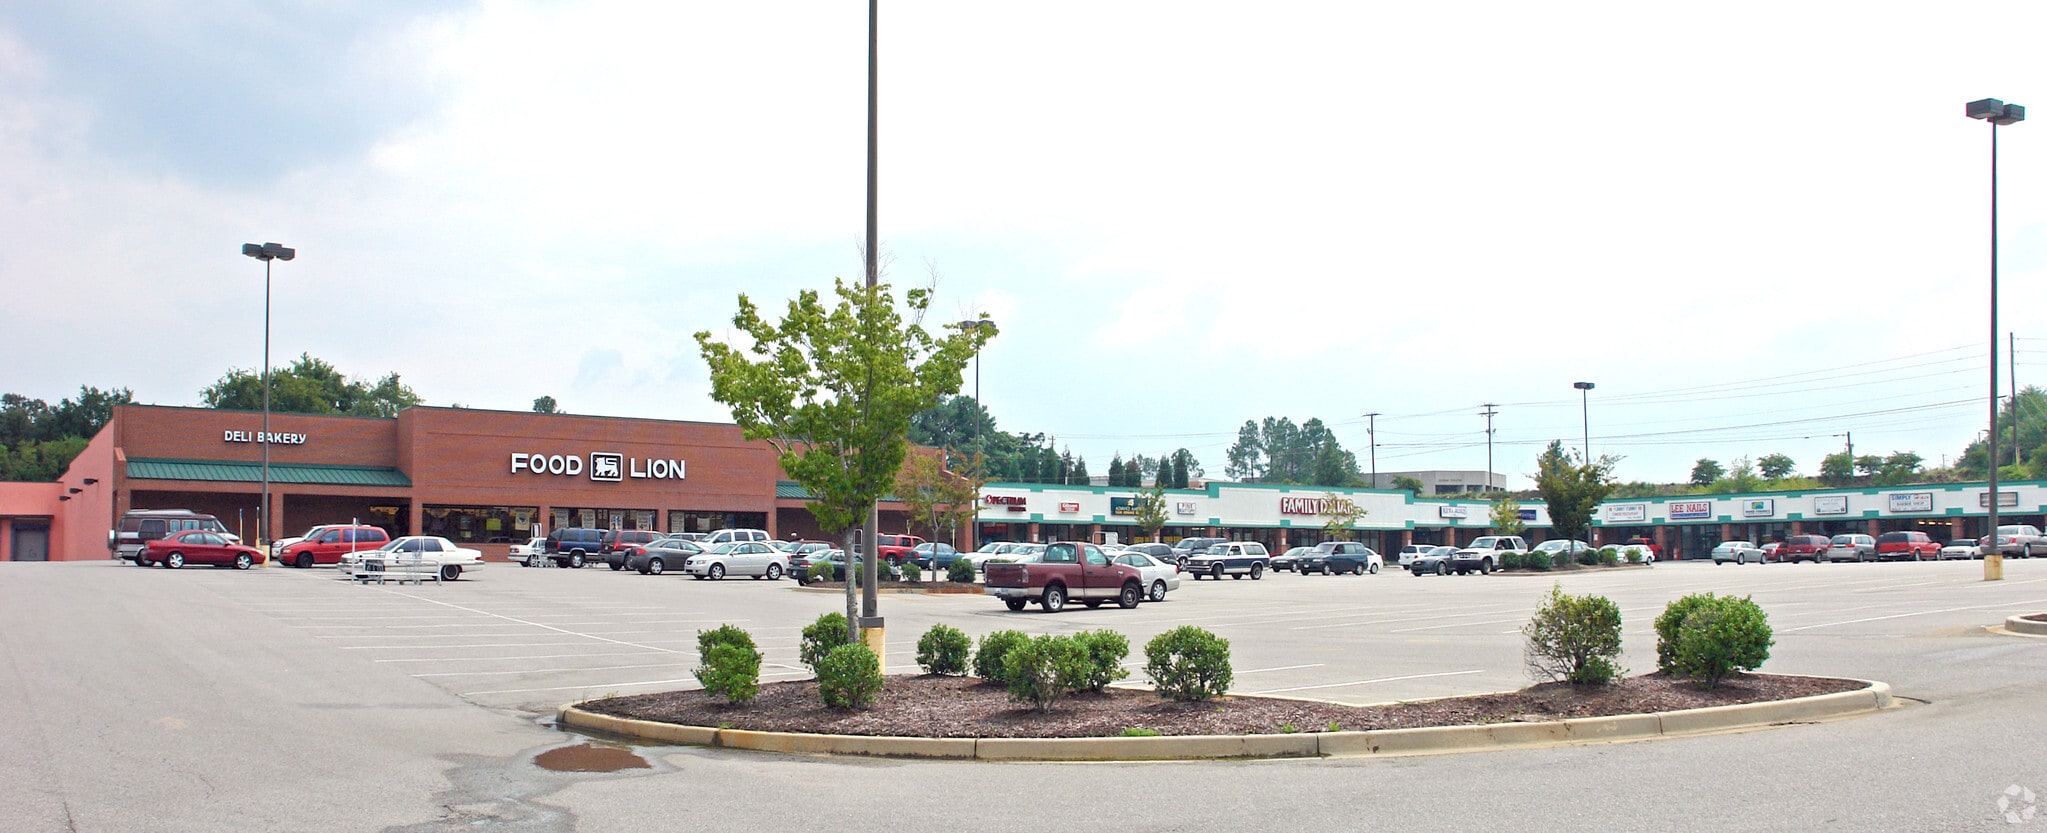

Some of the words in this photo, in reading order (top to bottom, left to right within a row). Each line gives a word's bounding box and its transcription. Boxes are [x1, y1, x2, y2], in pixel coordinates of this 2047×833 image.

[224, 430, 252, 442] DELI
[257, 431, 307, 444] BAKERY
[511, 452, 583, 475] FOOD
[630, 457, 686, 479] LION
[1281, 497, 1318, 515] FAMILY
[1671, 504, 1684, 513] LEE
[1686, 503, 1708, 512] NAILS
